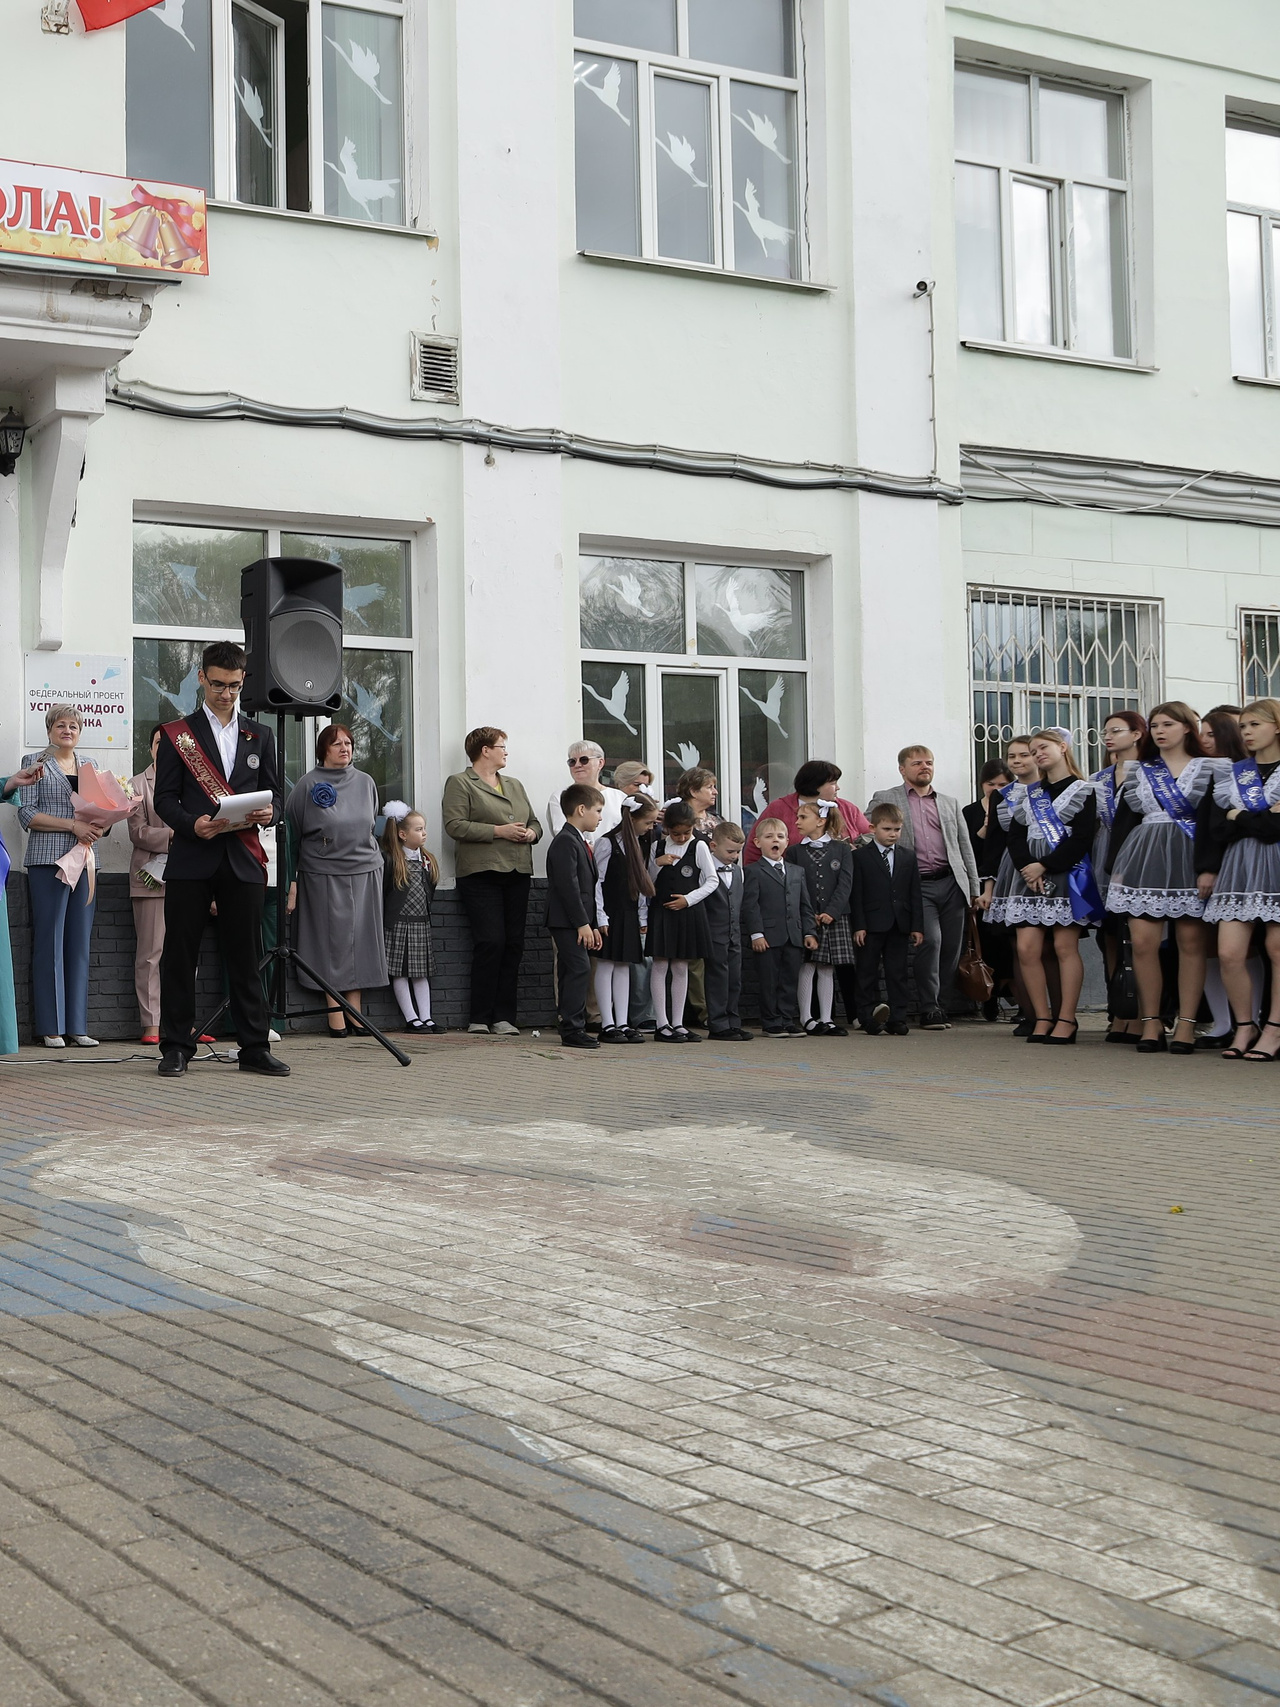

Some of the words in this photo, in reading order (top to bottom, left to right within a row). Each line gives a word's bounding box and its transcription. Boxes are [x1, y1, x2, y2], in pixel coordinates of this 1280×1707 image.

[29, 689, 92, 699] ФЕДЕРАЛЬНЫЙ
[93, 691, 125, 700] ПРОЕКТ
[29, 702, 58, 712] УСП
[70, 703, 125, 715] АЖДОГО
[185, 750, 227, 798] Выпускни
